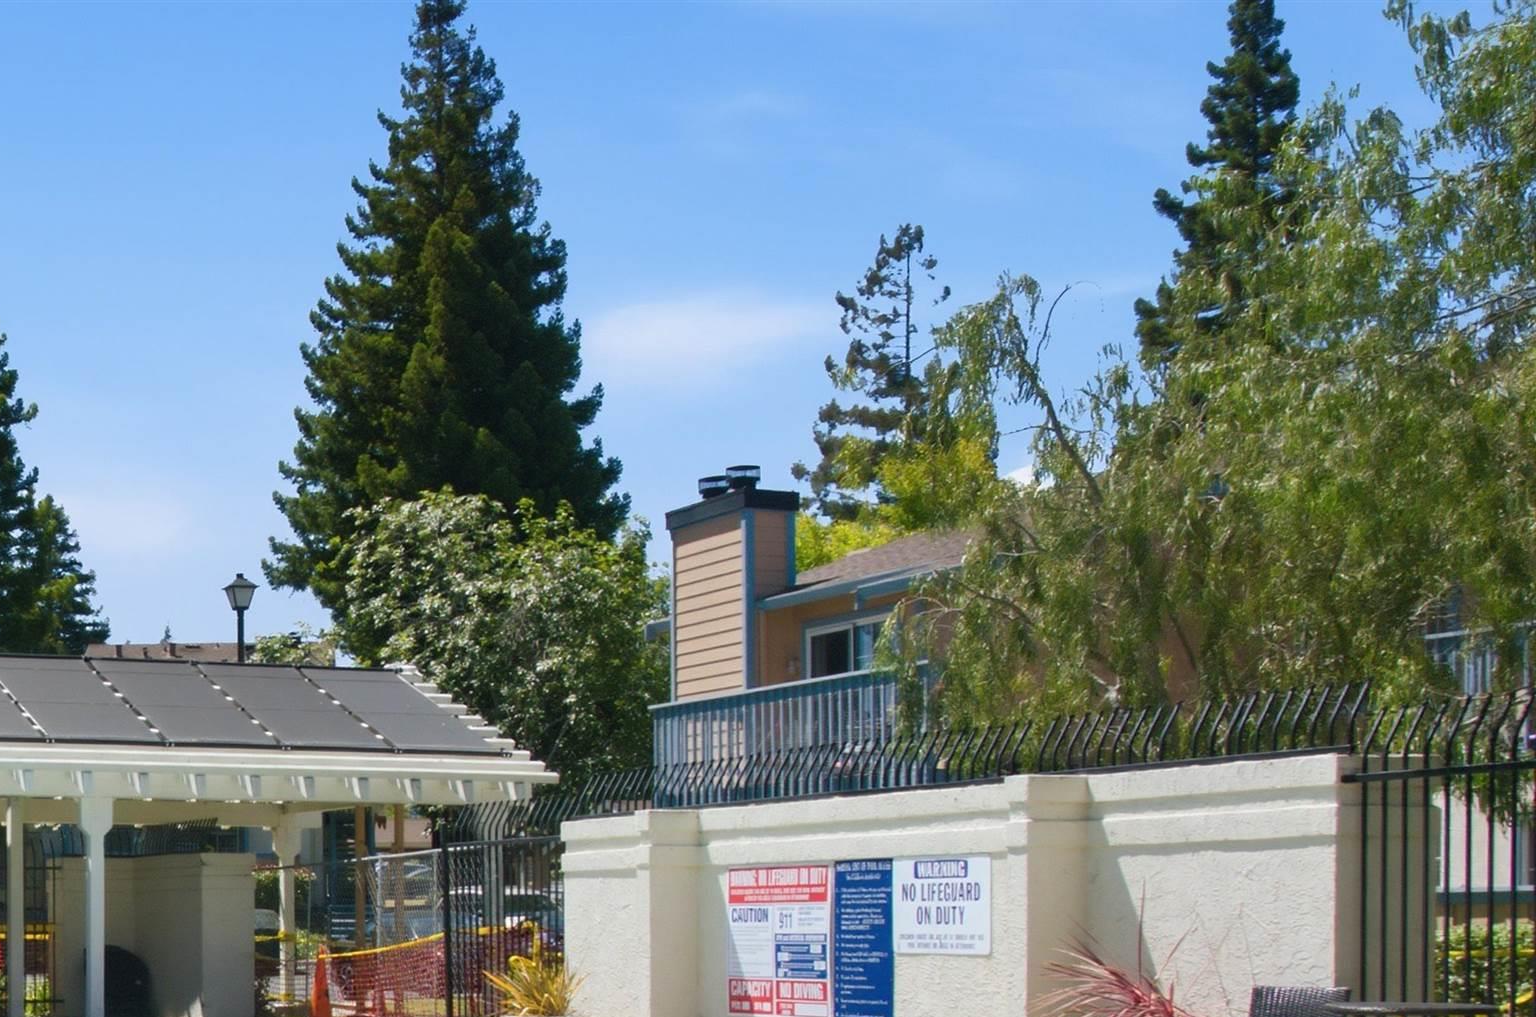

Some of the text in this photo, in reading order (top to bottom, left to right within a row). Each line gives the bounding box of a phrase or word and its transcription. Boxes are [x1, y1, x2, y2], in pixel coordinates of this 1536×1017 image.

[917, 861, 966, 877] WARNING
[901, 883, 916, 902] NO
[921, 882, 981, 902] LIFEGUARD
[731, 908, 769, 923] CAUTION
[778, 912, 793, 929] 911
[916, 906, 965, 925] ON DUTY
[731, 980, 771, 997] CAPACITY
[779, 982, 792, 998] NO
[793, 983, 824, 1000] DIVING
